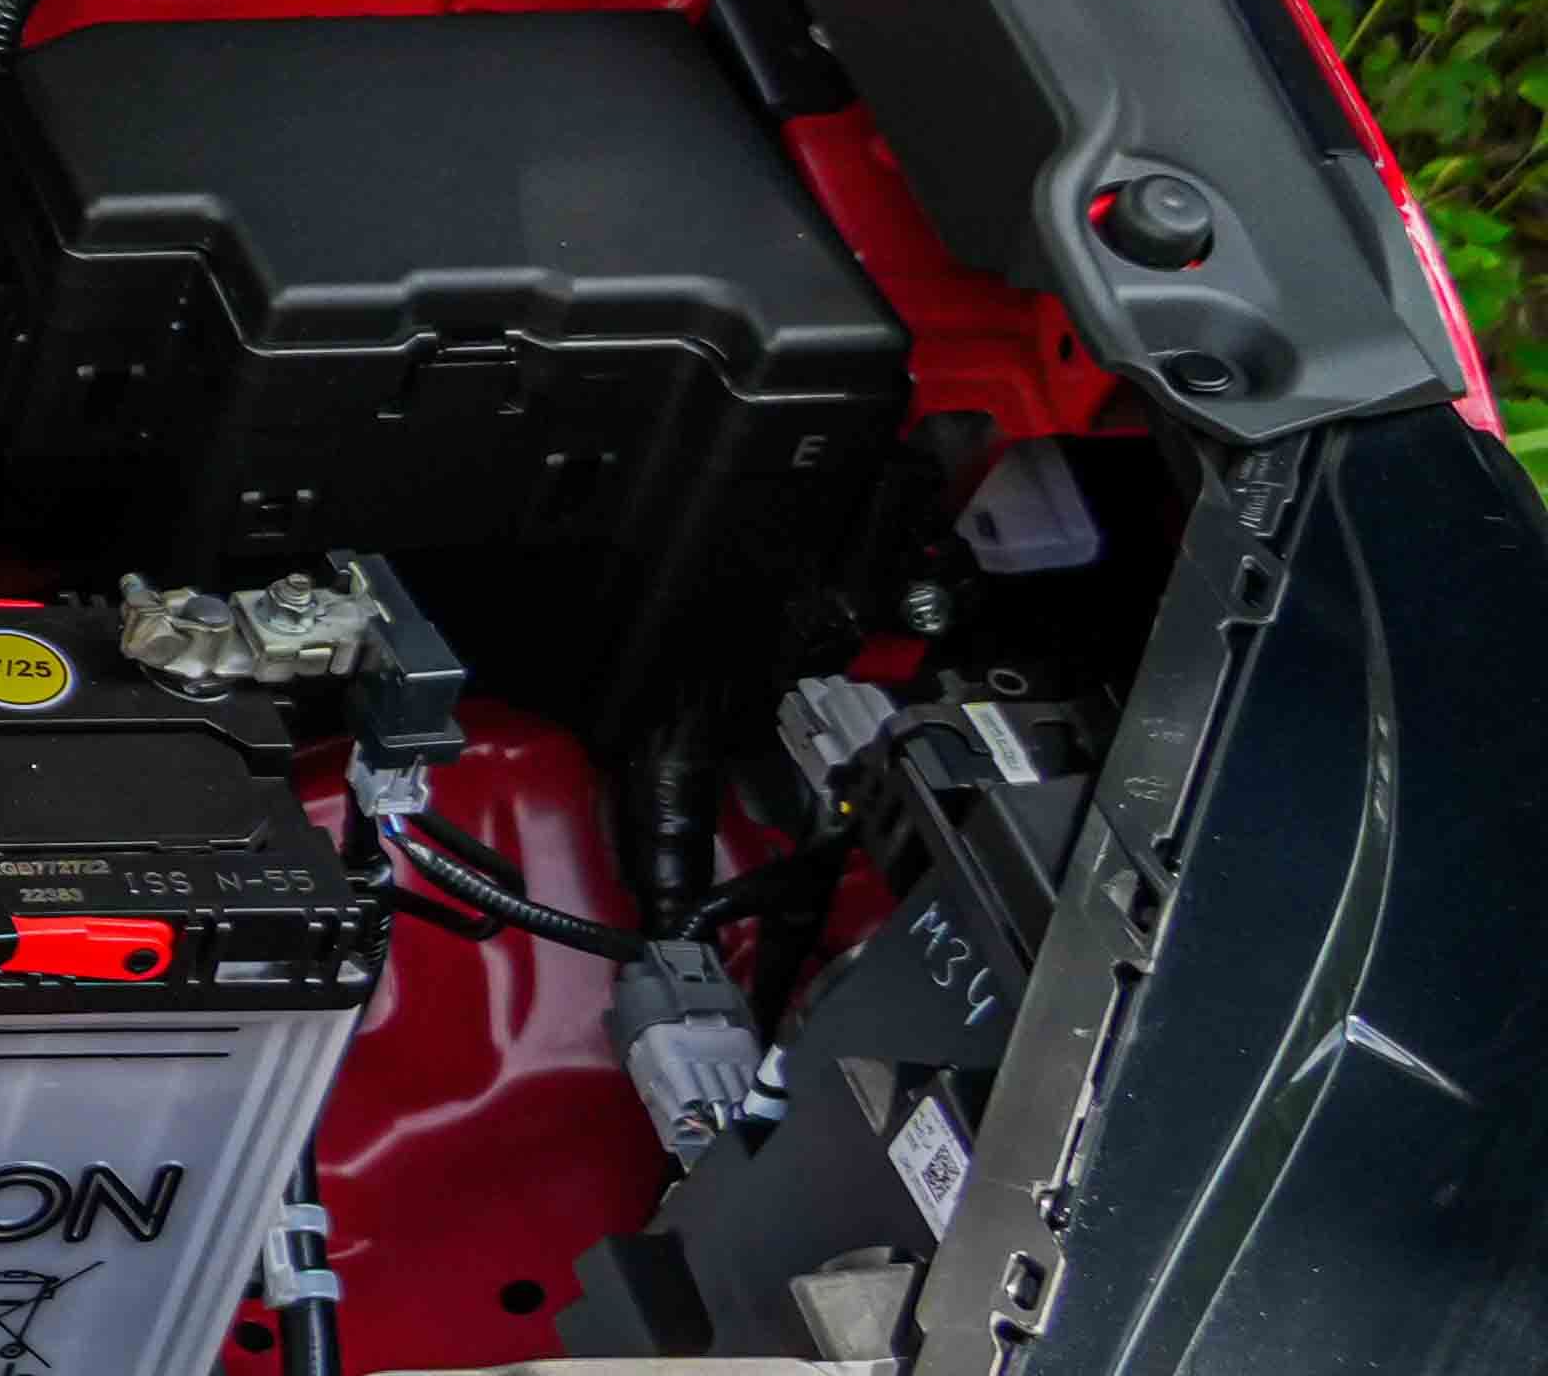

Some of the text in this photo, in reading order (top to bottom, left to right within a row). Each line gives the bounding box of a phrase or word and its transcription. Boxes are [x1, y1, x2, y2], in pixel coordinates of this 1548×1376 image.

[791, 434, 826, 469] E
[124, 868, 317, 895] ISS N-55
